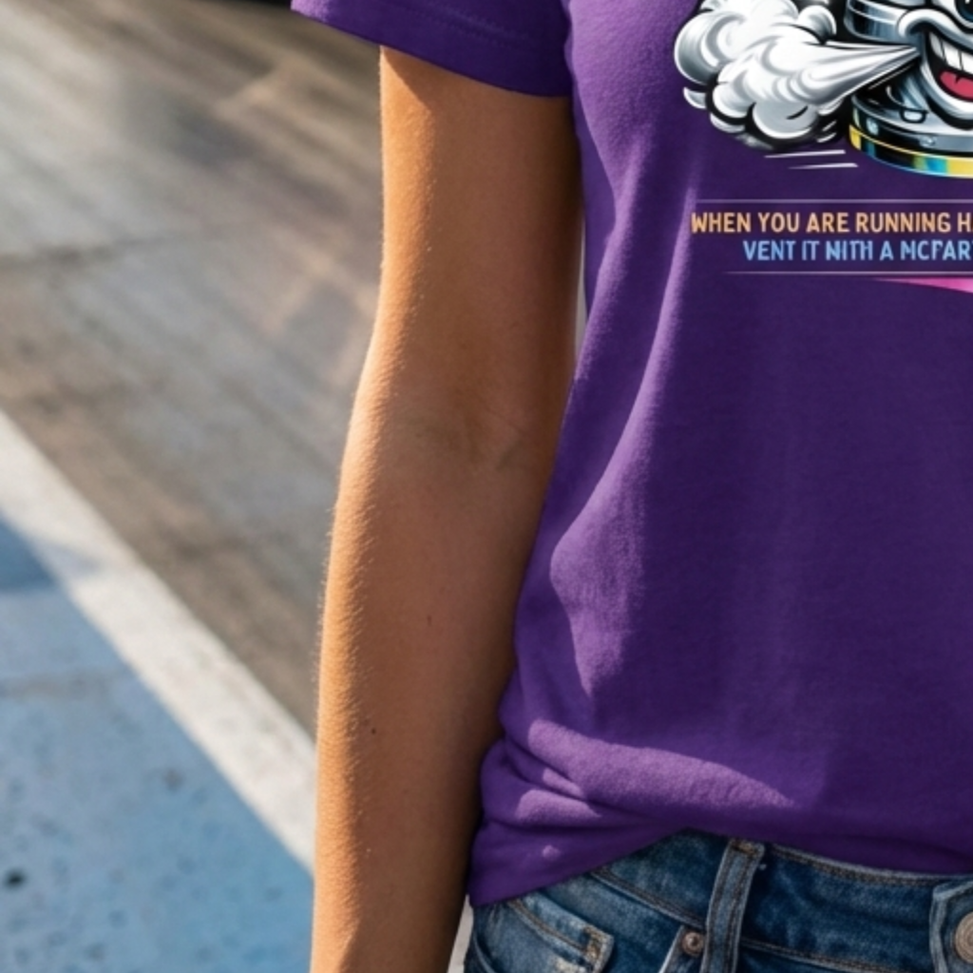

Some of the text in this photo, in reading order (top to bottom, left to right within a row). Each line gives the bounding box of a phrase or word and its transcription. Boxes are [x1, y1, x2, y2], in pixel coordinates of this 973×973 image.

[691, 212, 751, 233] WHEN
[758, 212, 800, 233] YOU
[806, 212, 850, 233] ARE
[855, 212, 951, 233] RUNNING
[743, 240, 796, 261] VENT
[801, 240, 820, 261] IT
[879, 240, 894, 261] A
